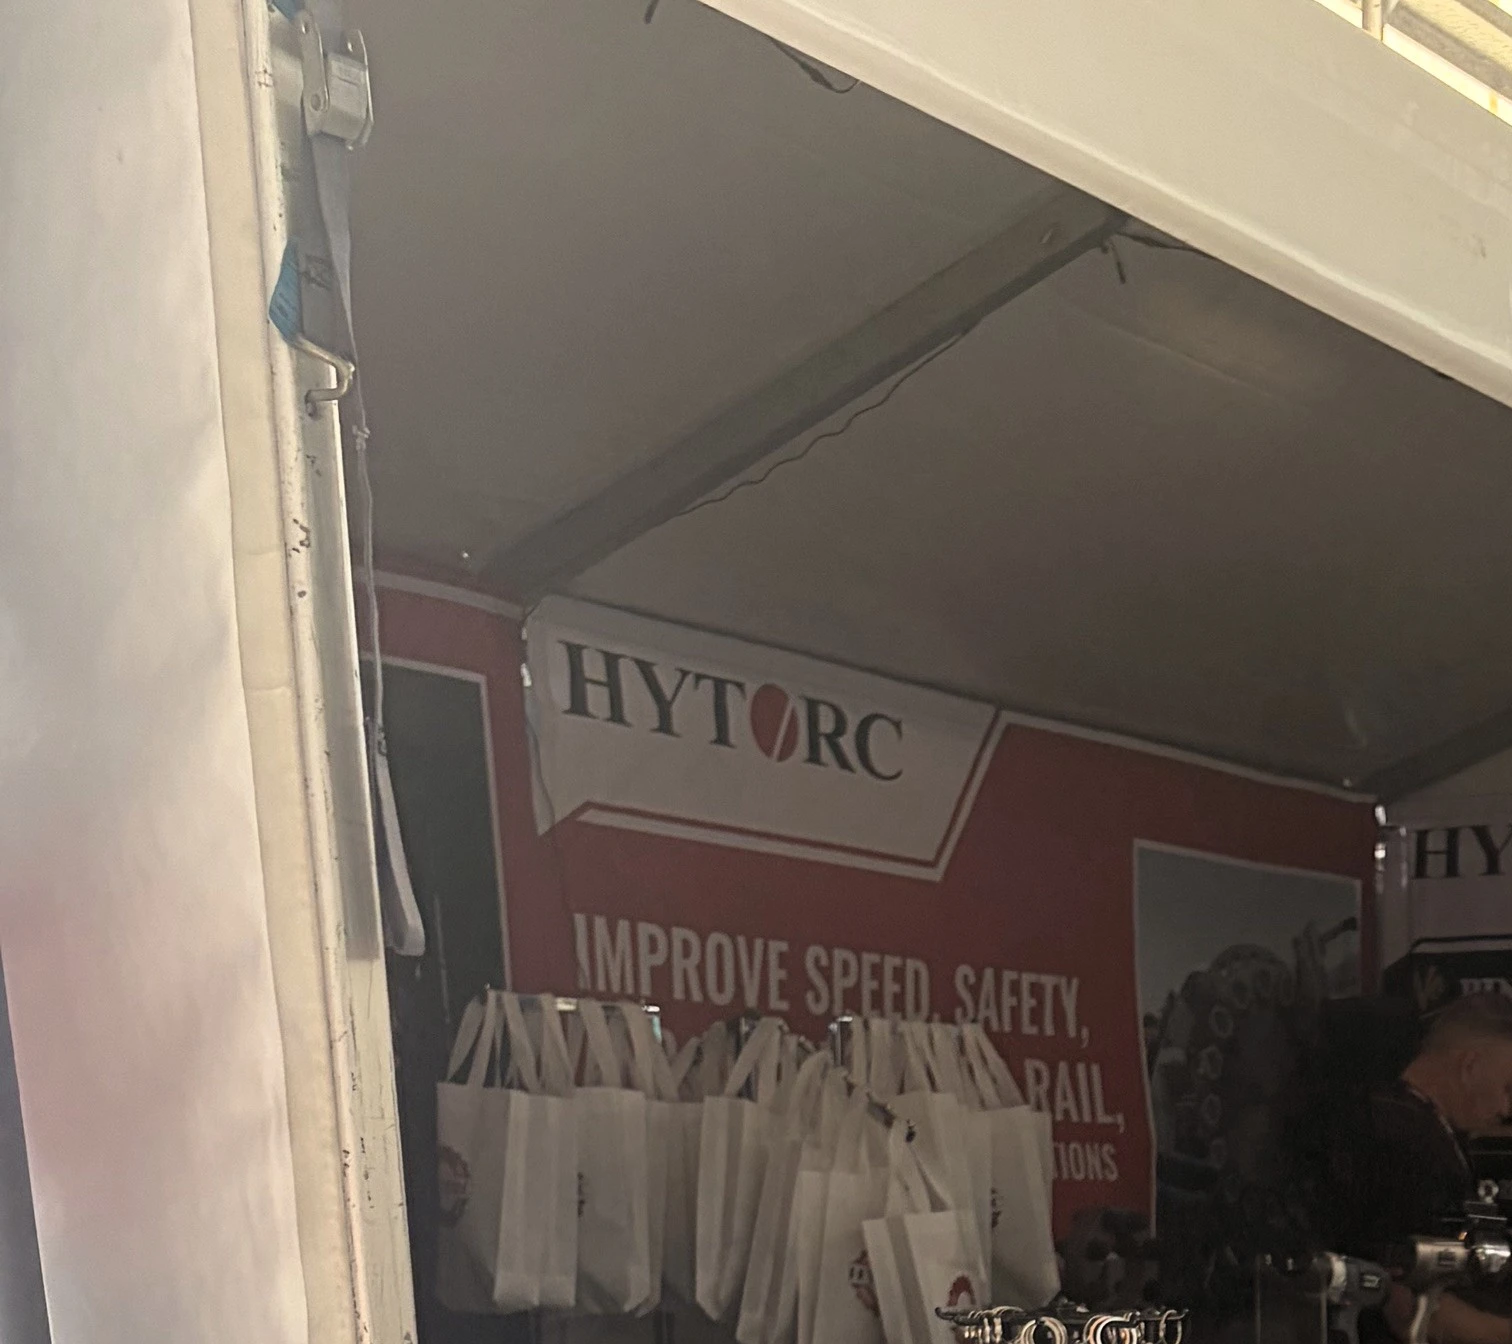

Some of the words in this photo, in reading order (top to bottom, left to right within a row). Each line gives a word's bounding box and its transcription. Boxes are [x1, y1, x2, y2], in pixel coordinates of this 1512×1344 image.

[557, 639, 905, 782] HYTORC
[573, 913, 790, 1012] IMPROVE
[954, 963, 1090, 1048] SAFETY,
